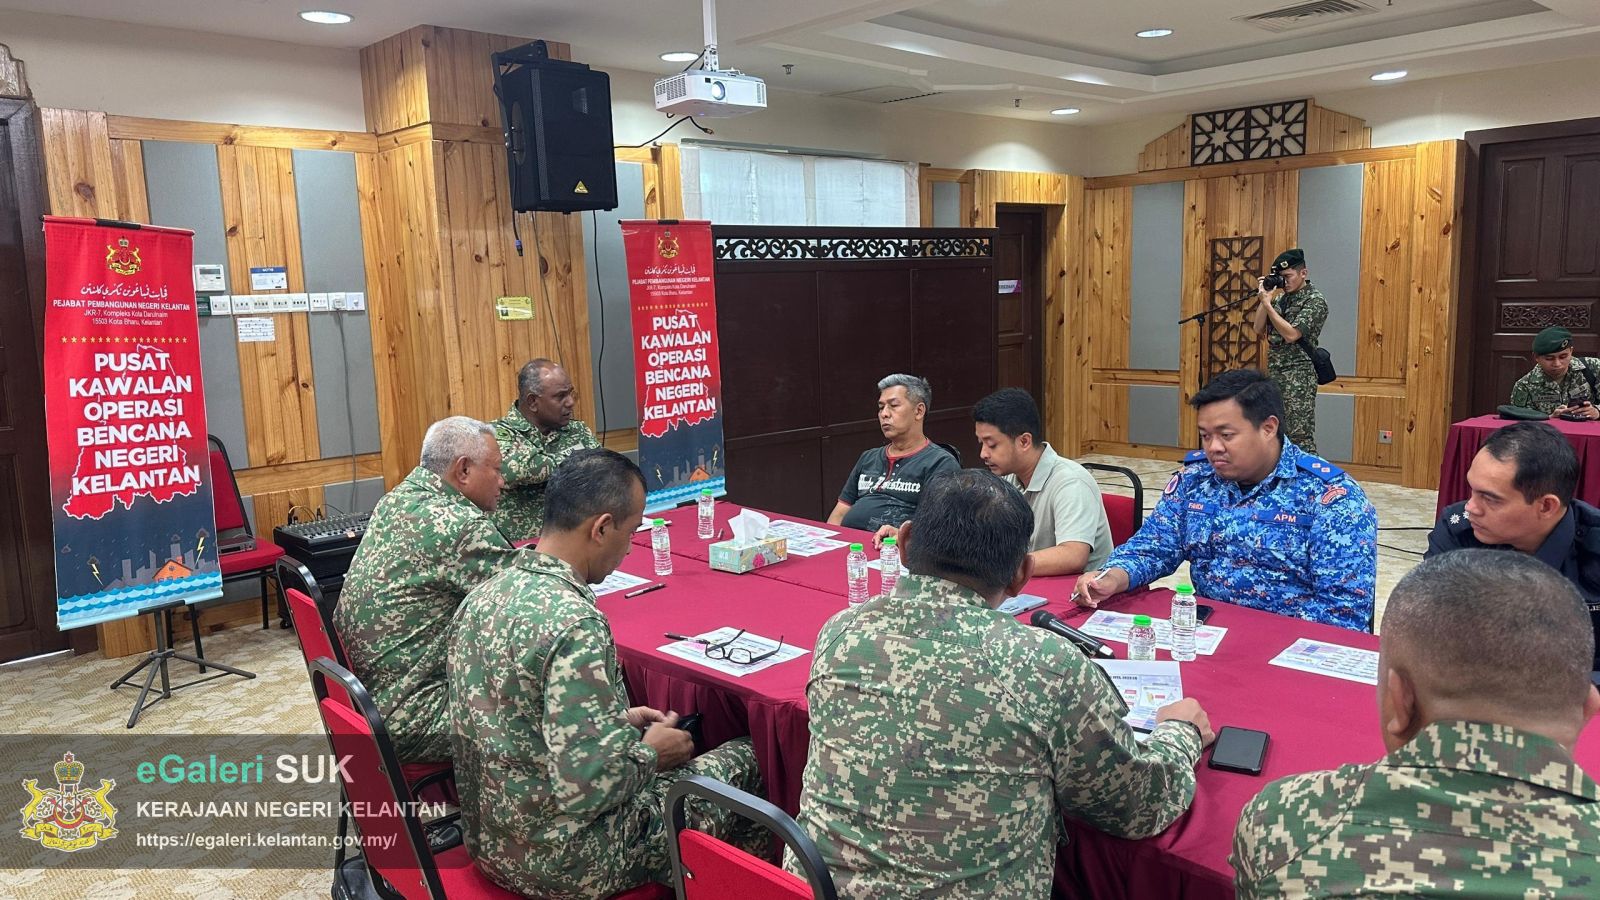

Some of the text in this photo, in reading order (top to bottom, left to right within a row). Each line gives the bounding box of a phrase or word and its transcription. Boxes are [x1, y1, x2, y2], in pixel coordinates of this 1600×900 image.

[88, 301, 137, 309] PEMBANGUNAN
[138, 302, 160, 310] NEGERI
[161, 303, 190, 311] KELANTAN
[103, 310, 131, 318] Kompleks
[653, 314, 697, 330] PUSAT
[641, 331, 711, 349] KAWALAN
[95, 352, 170, 372] PUSAT
[648, 348, 706, 367] OPERASI
[645, 365, 711, 385] BENCANA
[69, 375, 192, 397] KAWALAN
[655, 382, 704, 401] NEGERI
[84, 398, 183, 421] OPERASI
[644, 397, 716, 420] KELANTAN
[77, 421, 192, 447] BENCANA
[95, 444, 179, 469] NEGERI
[72, 465, 200, 496] KELANTAN
[1273, 513, 1297, 523] APM
